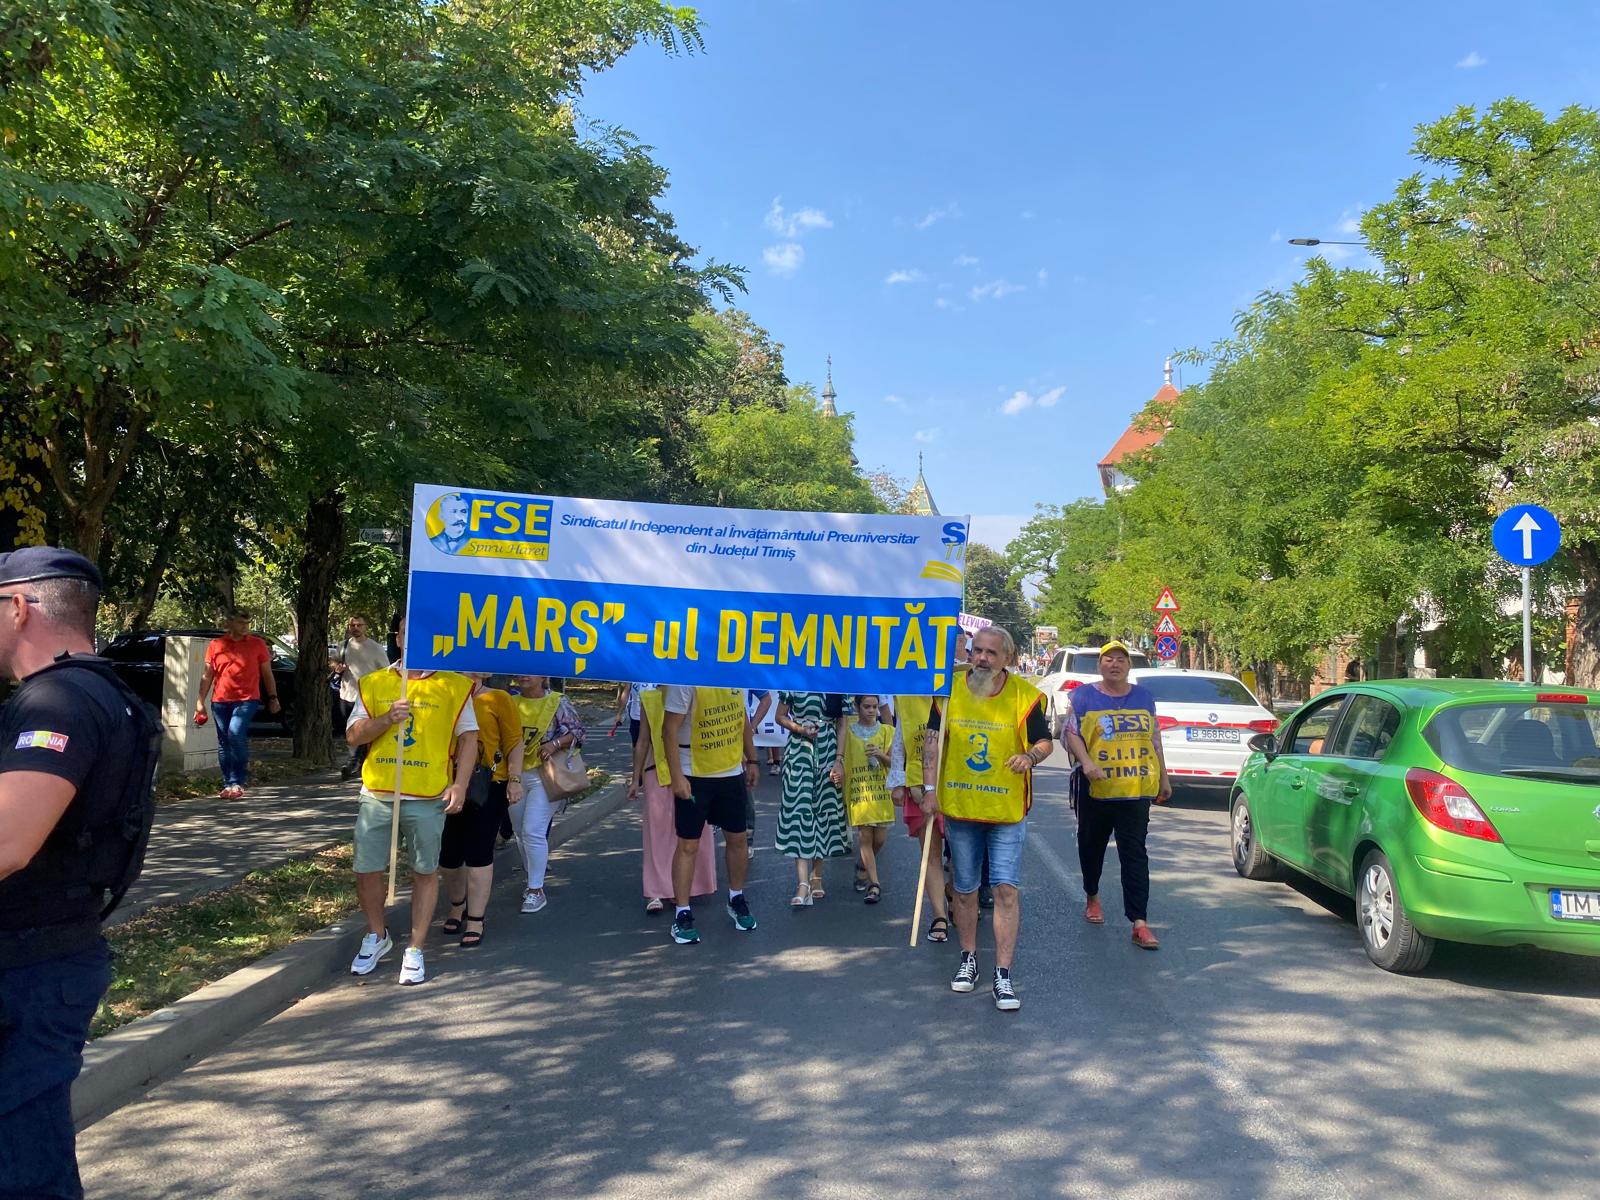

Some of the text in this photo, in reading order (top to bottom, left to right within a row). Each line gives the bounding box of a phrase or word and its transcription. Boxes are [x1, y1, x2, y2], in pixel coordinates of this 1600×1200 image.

[469, 499, 550, 536] FSE
[560, 514, 628, 530] Sindicatul
[629, 519, 713, 536] Independent
[715, 526, 728, 537] al
[827, 530, 919, 545] Preuniversitar
[468, 542, 545, 556] Spiru Haret
[685, 542, 796, 561] din Județul Timiș
[701, 730, 715, 740] DIN
[947, 781, 1009, 795] SPIRU HARET
